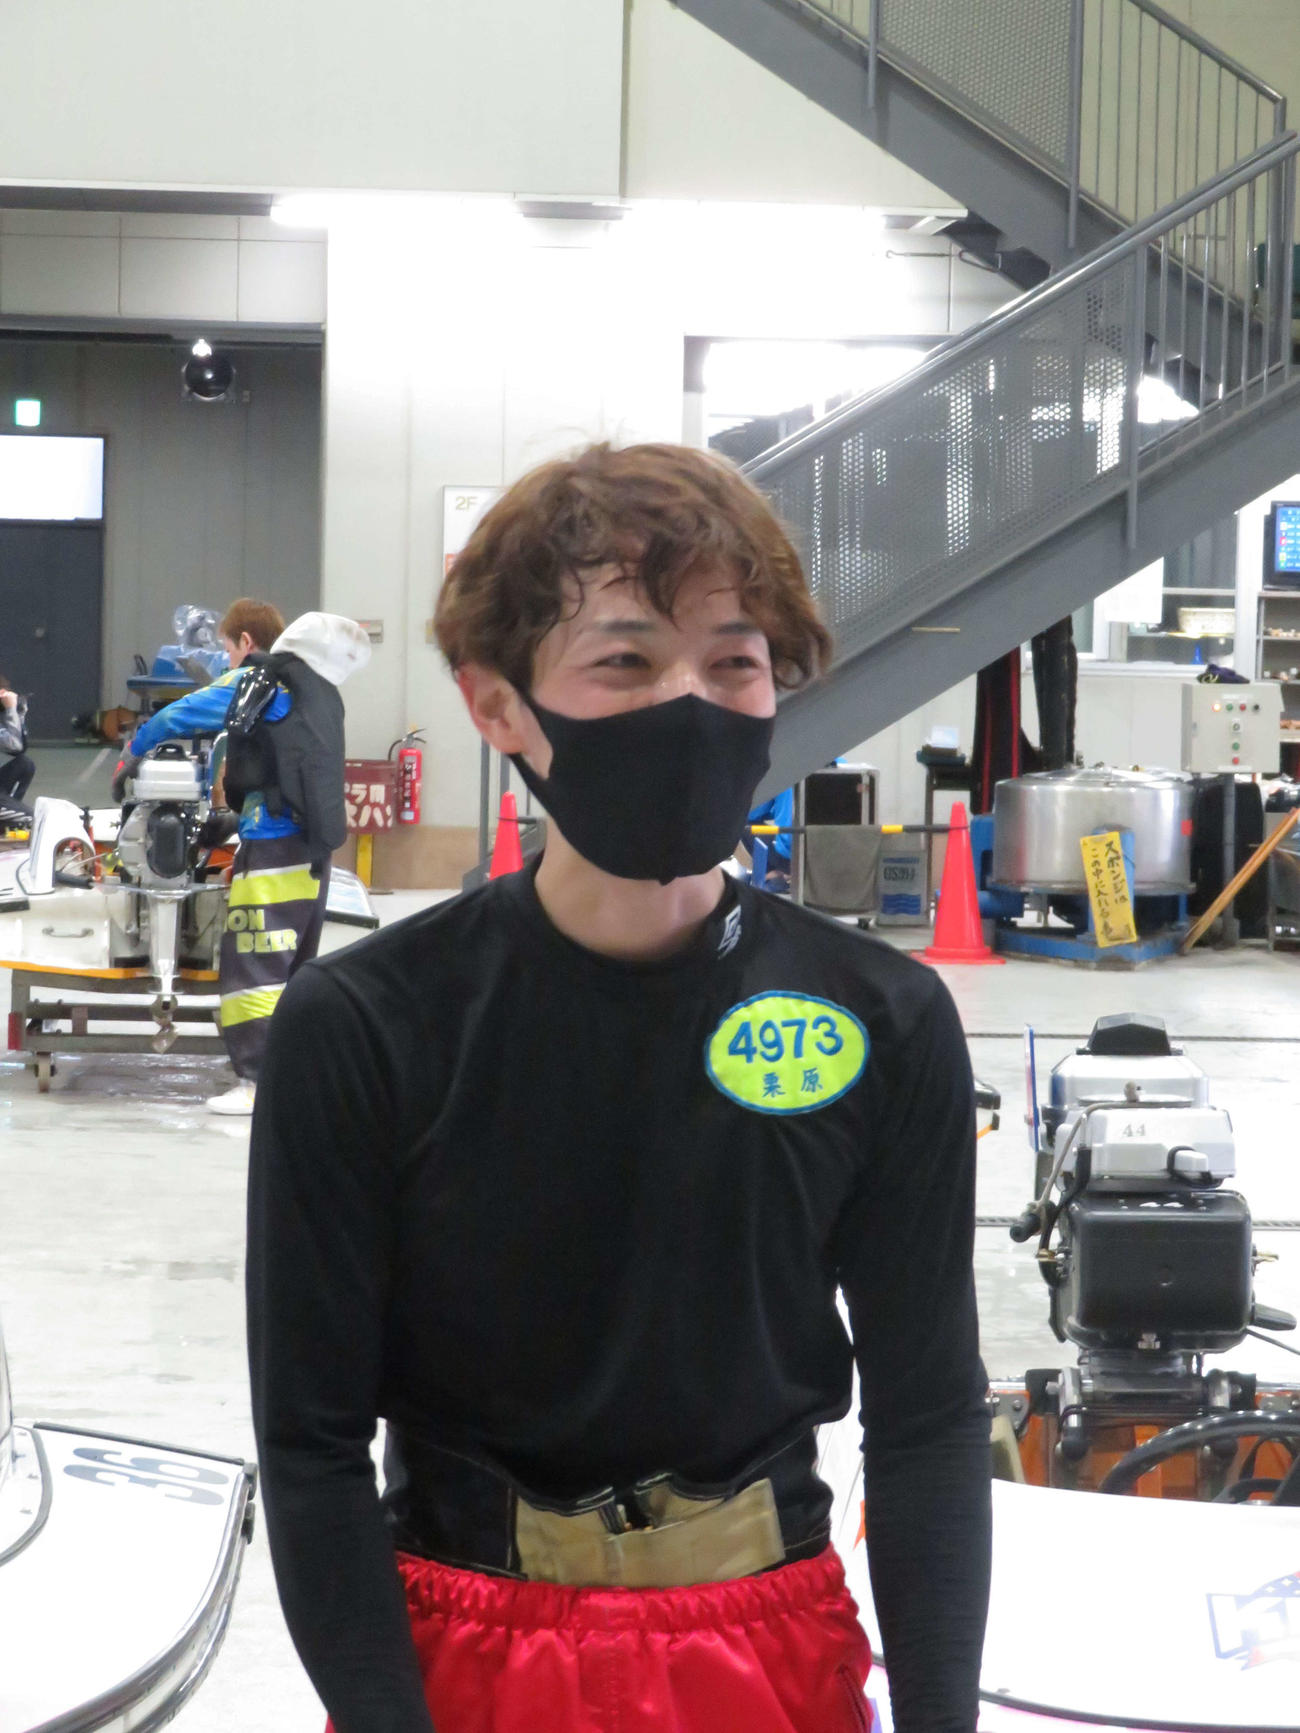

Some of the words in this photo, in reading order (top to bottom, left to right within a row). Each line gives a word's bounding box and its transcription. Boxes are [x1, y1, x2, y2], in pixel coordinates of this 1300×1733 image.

[455, 495, 478, 512] 2F
[224, 908, 265, 932] ON
[236, 928, 298, 954] BEER
[727, 1014, 844, 1064] 4973
[762, 1067, 823, 1098] 栗原
[1122, 1123, 1146, 1137] 44
